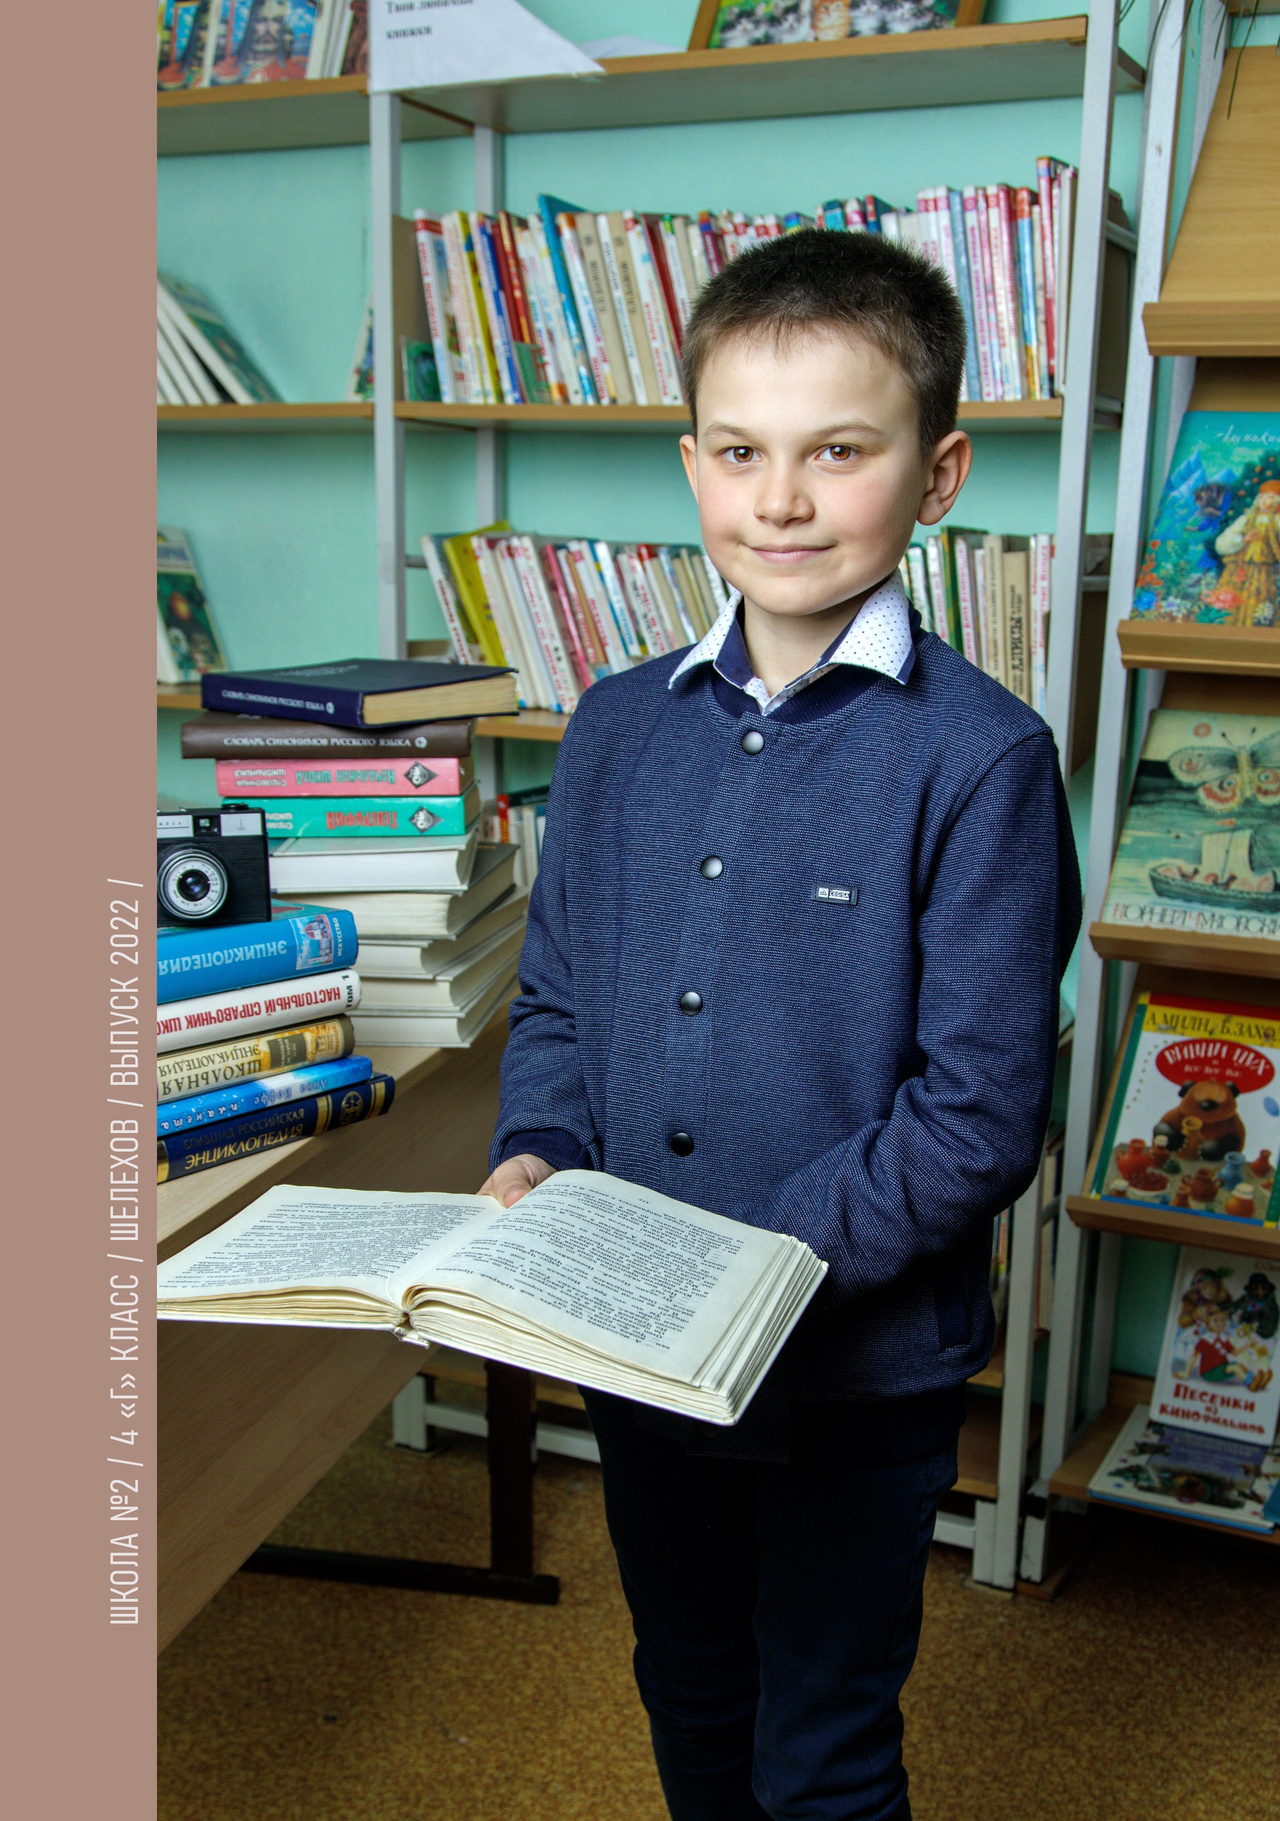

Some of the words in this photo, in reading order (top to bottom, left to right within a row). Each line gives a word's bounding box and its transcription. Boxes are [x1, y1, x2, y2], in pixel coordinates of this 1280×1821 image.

[224, 737, 265, 746] СЛОВАРЬ
[266, 737, 328, 746] СИНОНИМОВ
[330, 737, 376, 746] РУССКОГО
[378, 738, 411, 747] ЯЗЫКА
[158, 940, 287, 976] ЭНЦИКЛОПЕДИЯ
[186, 1002, 262, 1030] СПРАВОЧНИК
[264, 986, 341, 1017] НАСТОЛЬНЫЙ
[158, 1043, 261, 1077] ЭНЦИКЛОПЕДИЯ
[162, 1059, 262, 1096] ШКОЛЬНАЯ
[238, 1108, 304, 1137] РОССИЙСКАЯ
[184, 1123, 303, 1170] ЭНЦИКЛОПЕДИЯ
